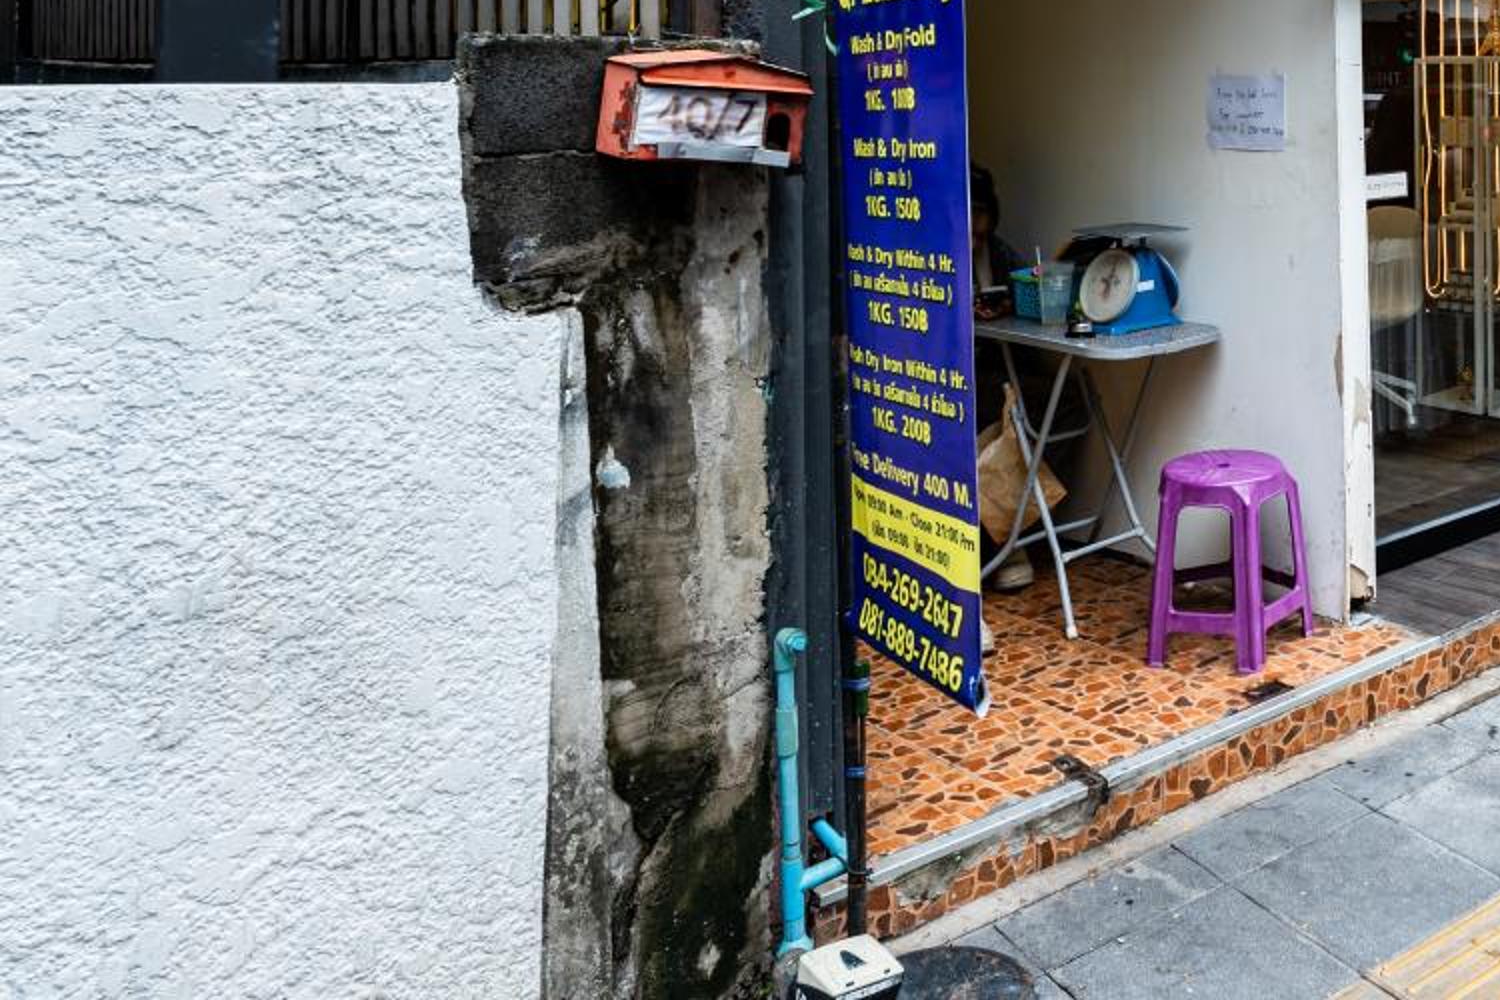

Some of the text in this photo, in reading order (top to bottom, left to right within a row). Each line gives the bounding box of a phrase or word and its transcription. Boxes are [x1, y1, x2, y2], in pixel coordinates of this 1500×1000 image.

[904, 23, 936, 47] Fold
[877, 138, 887, 158] &
[891, 137, 906, 163] Dry
[908, 138, 936, 159] Iron
[875, 246, 894, 269] Dry
[895, 249, 926, 270] Within
[928, 253, 936, 272] 4
[939, 254, 956, 273] Hr.
[868, 300, 895, 326] 1KG.
[866, 349, 879, 373] Dry
[883, 354, 903, 374] Iron
[905, 359, 937, 384] Within
[939, 367, 947, 386] 4
[951, 369, 968, 391] Hr.
[872, 406, 898, 434] 1KG.
[872, 452, 920, 496] Delivery
[923, 472, 949, 501] 400
[953, 480, 973, 509] M.
